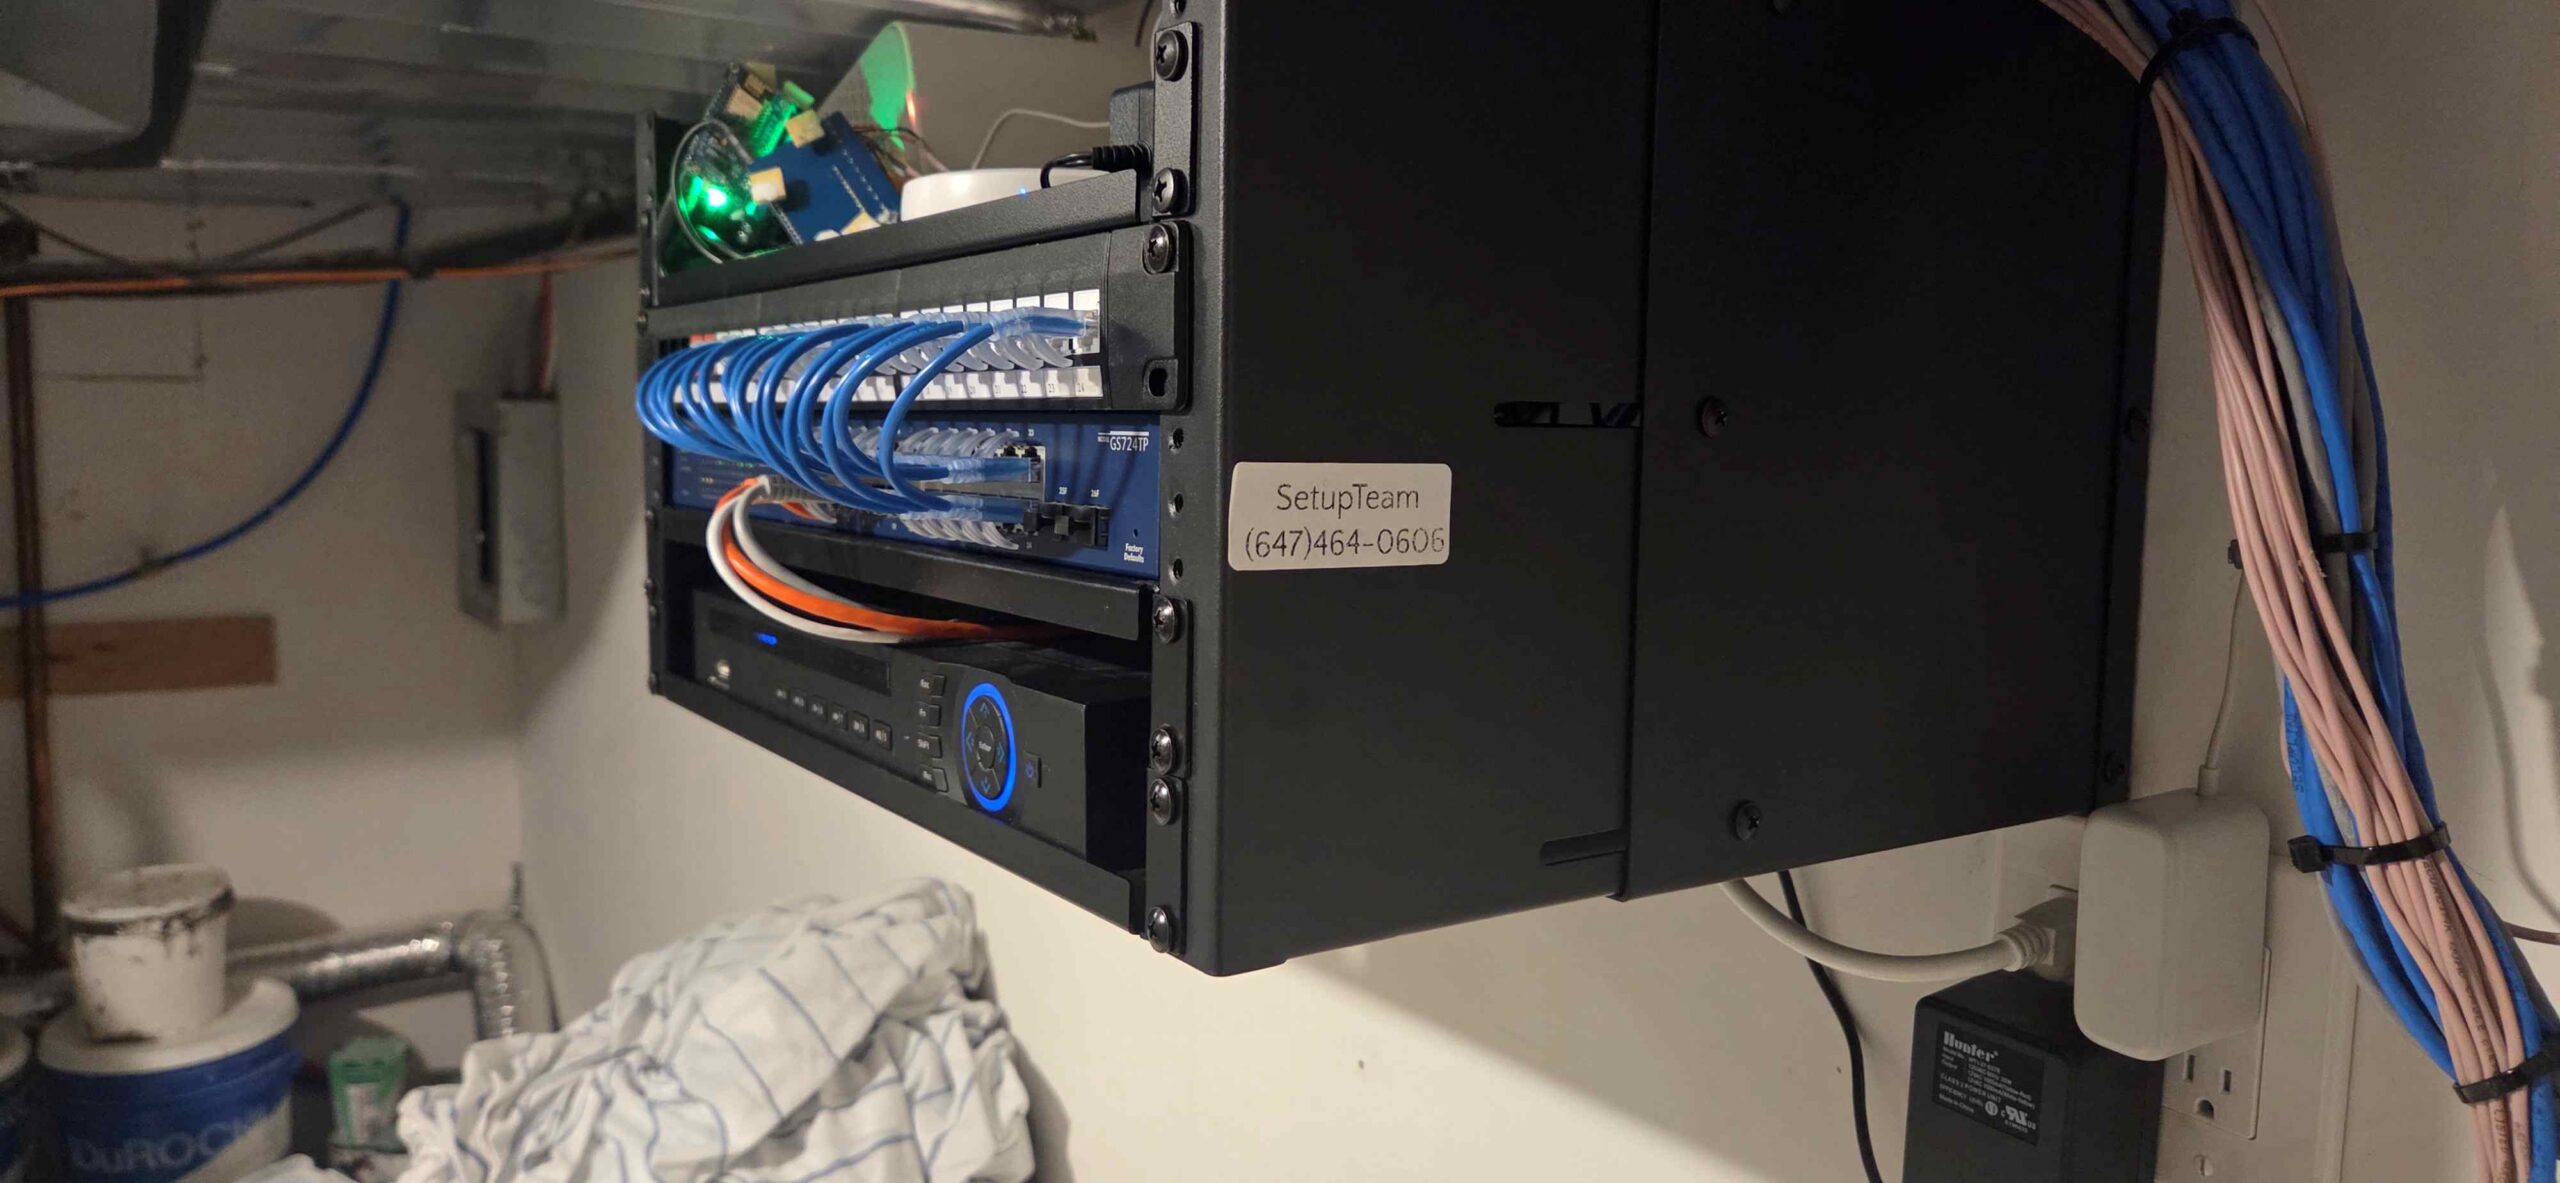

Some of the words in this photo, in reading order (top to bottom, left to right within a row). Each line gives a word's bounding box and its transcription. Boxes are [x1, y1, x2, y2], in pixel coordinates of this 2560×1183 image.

[1048, 383, 1055, 393] 23
[1077, 382, 1085, 392] 24
[1109, 436, 1150, 452] GS724TP
[1276, 483, 1420, 519] SetupTeam
[1245, 526, 1446, 562] (647)464-0606
[1943, 1030, 1995, 1062] Hunter
